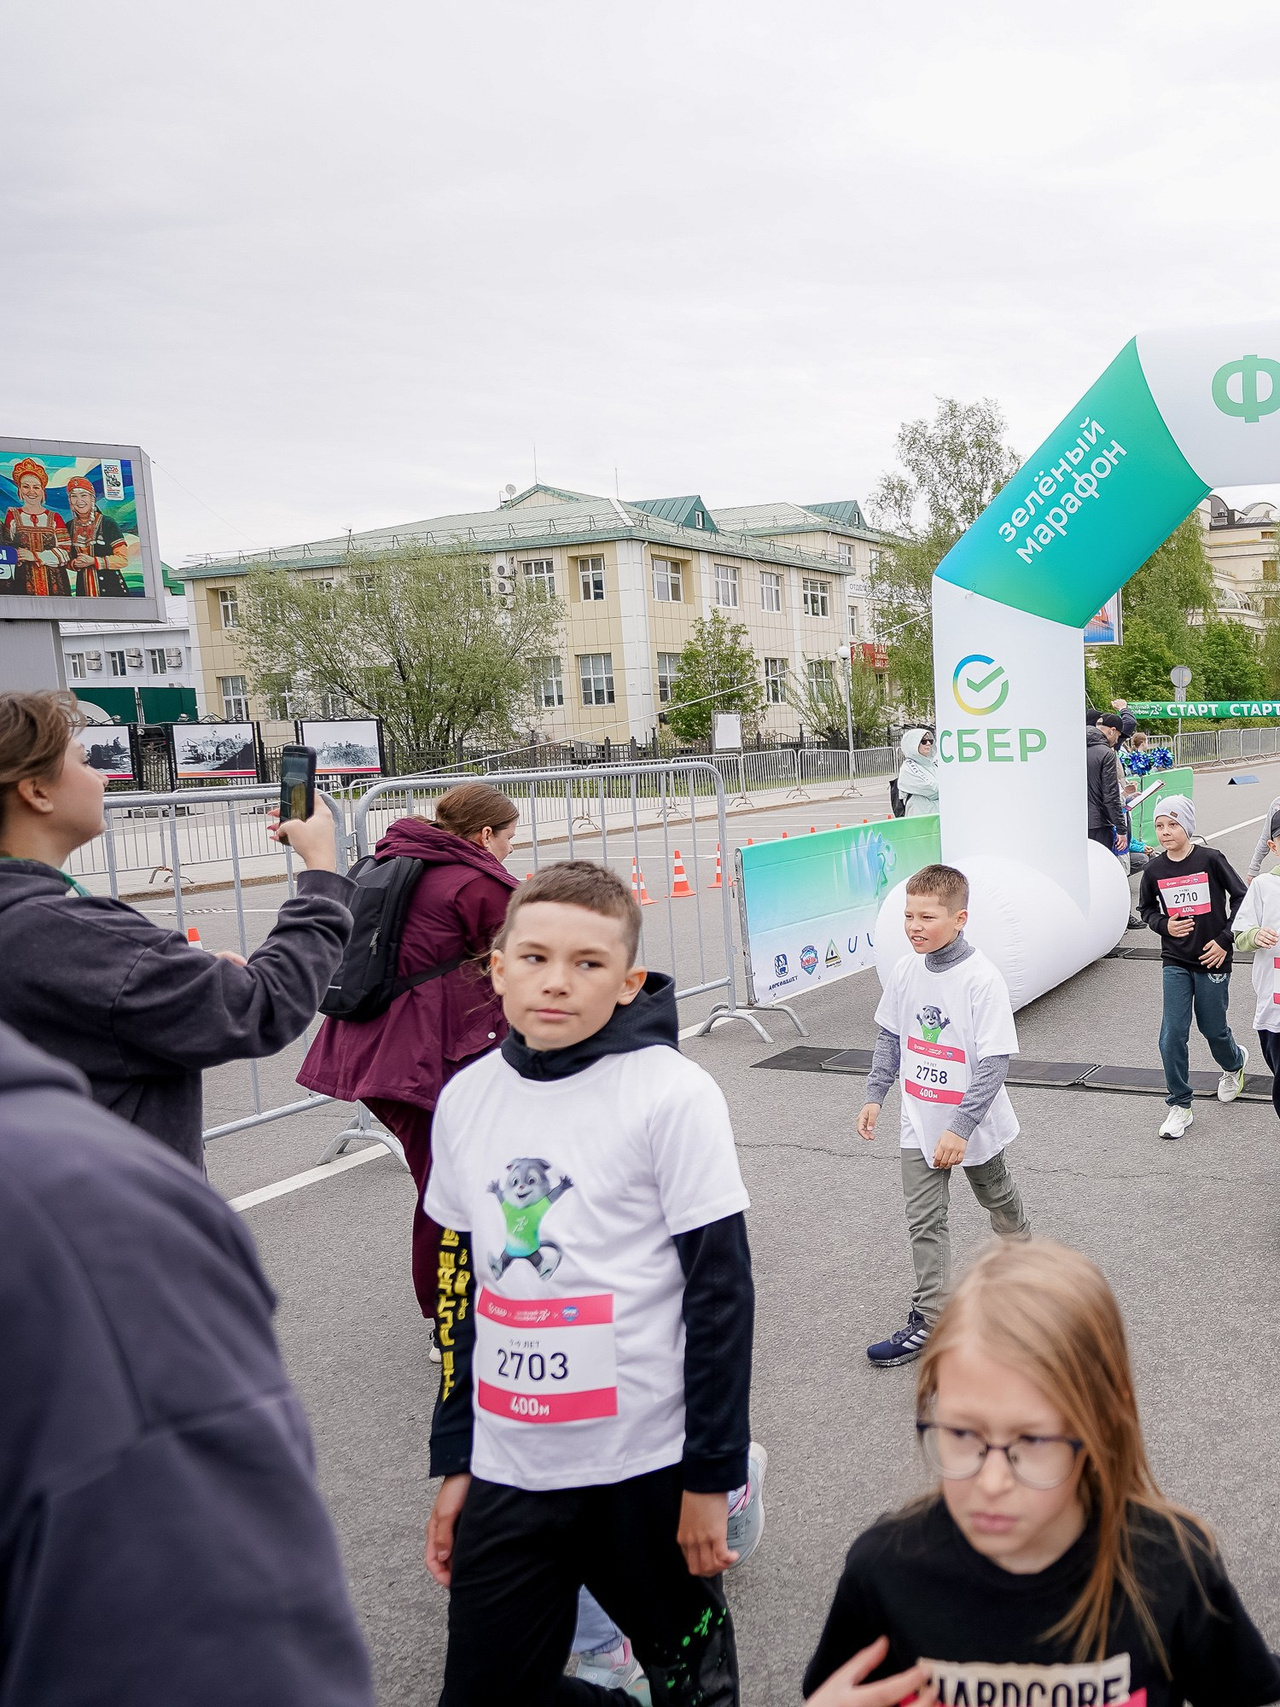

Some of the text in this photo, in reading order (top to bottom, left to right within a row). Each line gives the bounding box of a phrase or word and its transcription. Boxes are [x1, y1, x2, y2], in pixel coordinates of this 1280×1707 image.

[998, 416, 1107, 543] зелёный
[1015, 439, 1128, 565] марафон
[1166, 703, 1219, 717] СТАРТ
[939, 728, 1047, 763] СБЕР
[1173, 891, 1198, 904] 2710
[915, 1065, 948, 1085] 2758
[437, 1252, 457, 1347] FUTURE
[497, 1348, 569, 1382] 2703
